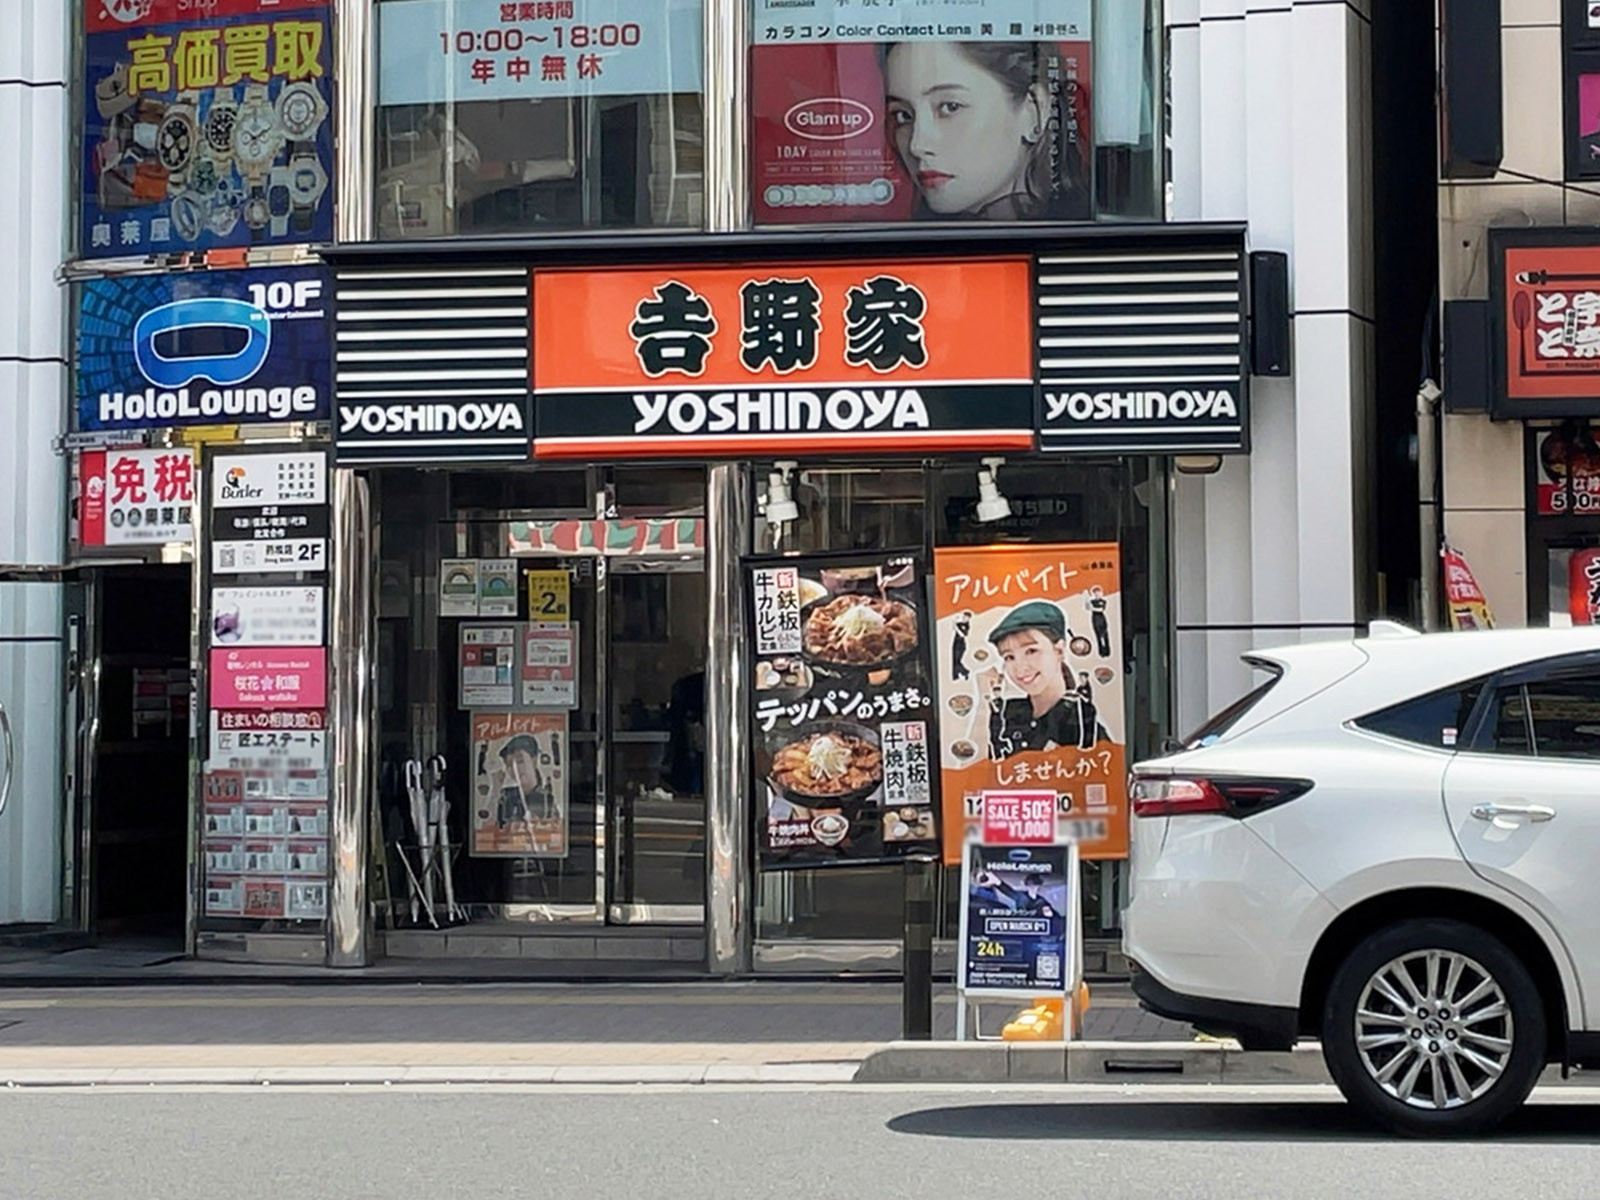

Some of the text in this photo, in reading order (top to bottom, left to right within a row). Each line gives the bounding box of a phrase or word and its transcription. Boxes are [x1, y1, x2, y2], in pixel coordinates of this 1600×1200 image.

[500, 2, 574, 22] 営業時間
[766, 26, 830, 40] カラコン
[836, 25, 873, 37] Color
[877, 24, 933, 37] Contact
[938, 23, 971, 36] Lens
[127, 22, 323, 95] 高価買取
[471, 54, 603, 84] 年中無休
[796, 111, 862, 128] Glam up
[249, 280, 322, 309] 10F
[100, 386, 316, 421] HoloLounge
[111, 455, 194, 505] 免税
[221, 484, 263, 499] Butler
[298, 543, 321, 561] 2F
[945, 562, 1078, 604] アルバイト
[756, 572, 777, 640] 牛カルビ
[777, 590, 799, 631] 鉄板
[884, 729, 905, 789] 牛焼肉
[905, 742, 927, 784] 鉄板
[988, 804, 1019, 820] SALE
[977, 941, 1004, 957] 24h
